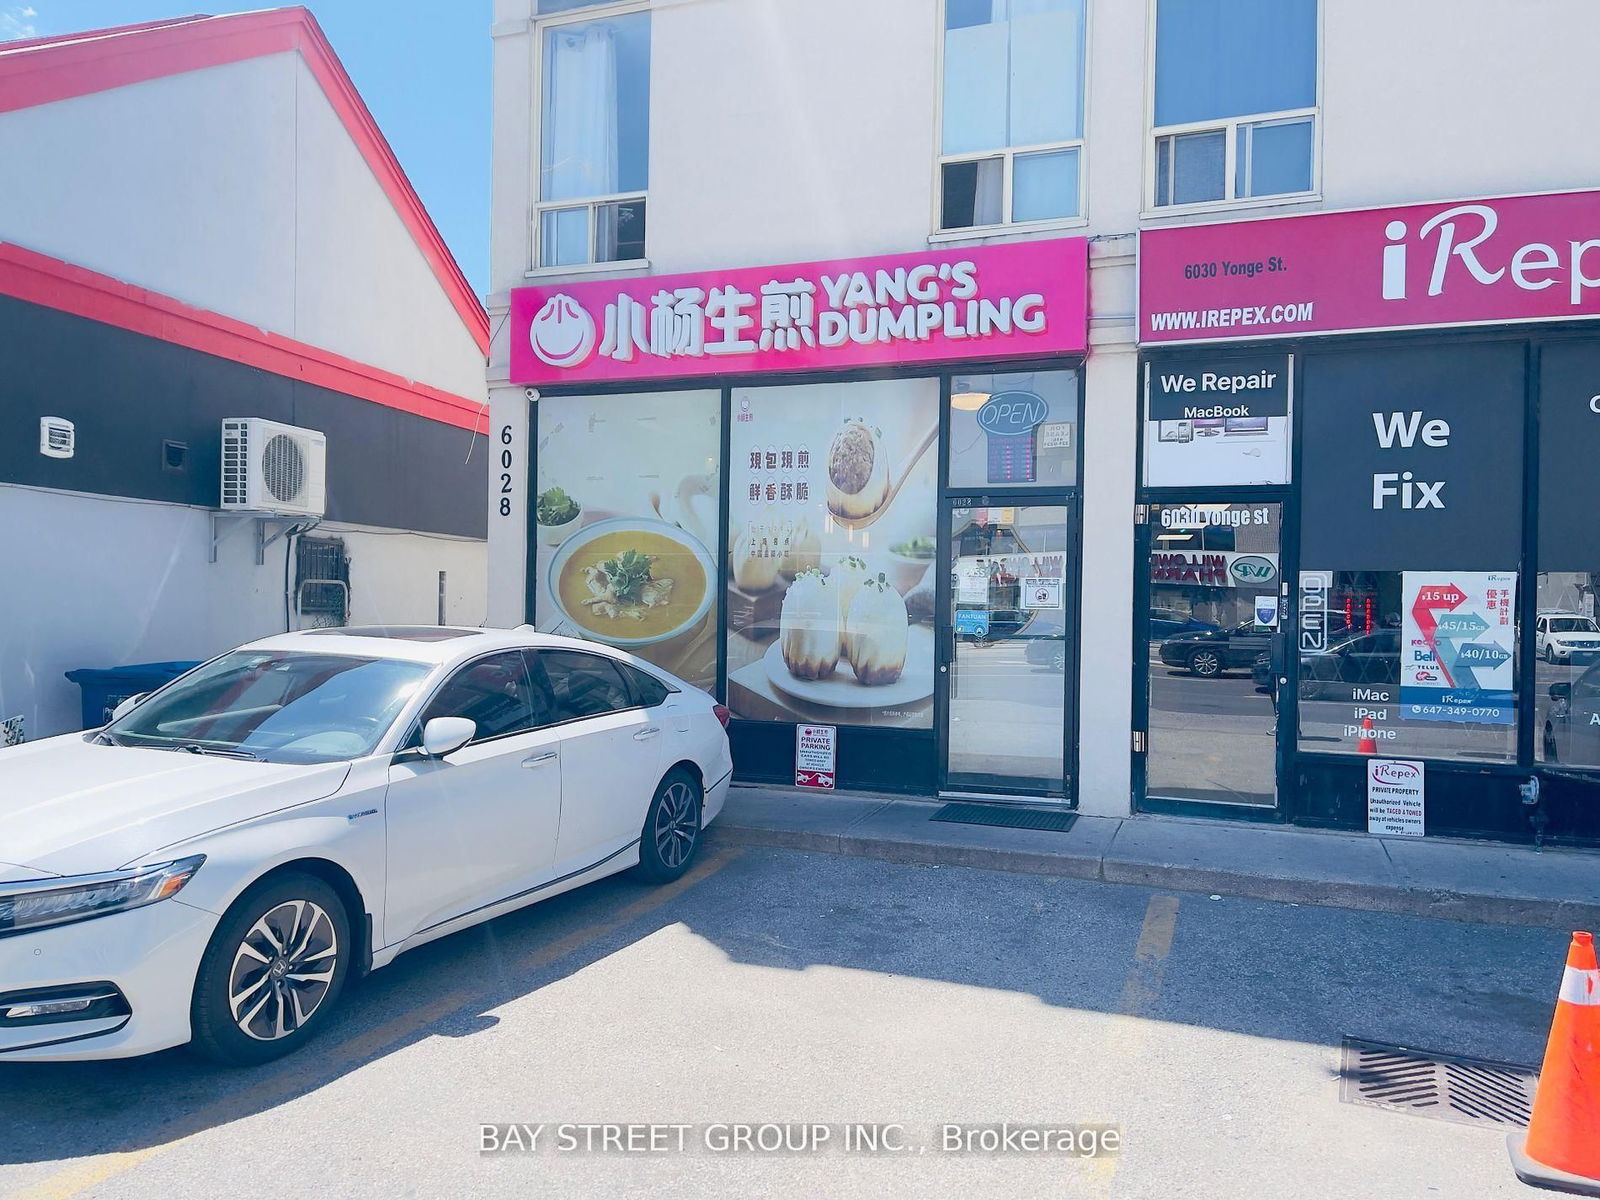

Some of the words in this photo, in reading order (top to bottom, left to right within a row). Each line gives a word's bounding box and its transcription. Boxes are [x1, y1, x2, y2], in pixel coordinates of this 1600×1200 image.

[1184, 261, 1217, 280] 6030
[1222, 259, 1264, 279] Yonge
[1268, 256, 1287, 273] St.
[820, 261, 978, 309] YANG'S
[598, 277, 816, 361] 小杨生煎
[818, 293, 1046, 348] DUMPLING
[1150, 302, 1314, 331] WWW.IREPEX.COM
[1160, 373, 1197, 394] We
[1201, 370, 1277, 392] Repair
[982, 402, 1040, 425] OPEN
[1184, 404, 1250, 419] MacBook
[1372, 411, 1450, 449] We
[500, 425, 513, 518] 6028
[1372, 470, 1446, 510] Fix
[1160, 507, 1201, 528] 6030
[1443, 593, 1460, 604] up
[1302, 577, 1322, 649] OPEN
[1352, 688, 1390, 702] iMac
[1354, 707, 1388, 721] iPad
[1422, 706, 1500, 717] 647-349-0770
[800, 736, 831, 745] PRIVATE
[1343, 724, 1397, 740] iPhone
[800, 742, 831, 751] PARKING
[1375, 764, 1416, 779] iRepex
[1372, 786, 1391, 794] PRIVATE
[1392, 787, 1419, 796] PROPERTY
[1402, 799, 1421, 807] Vehicle
